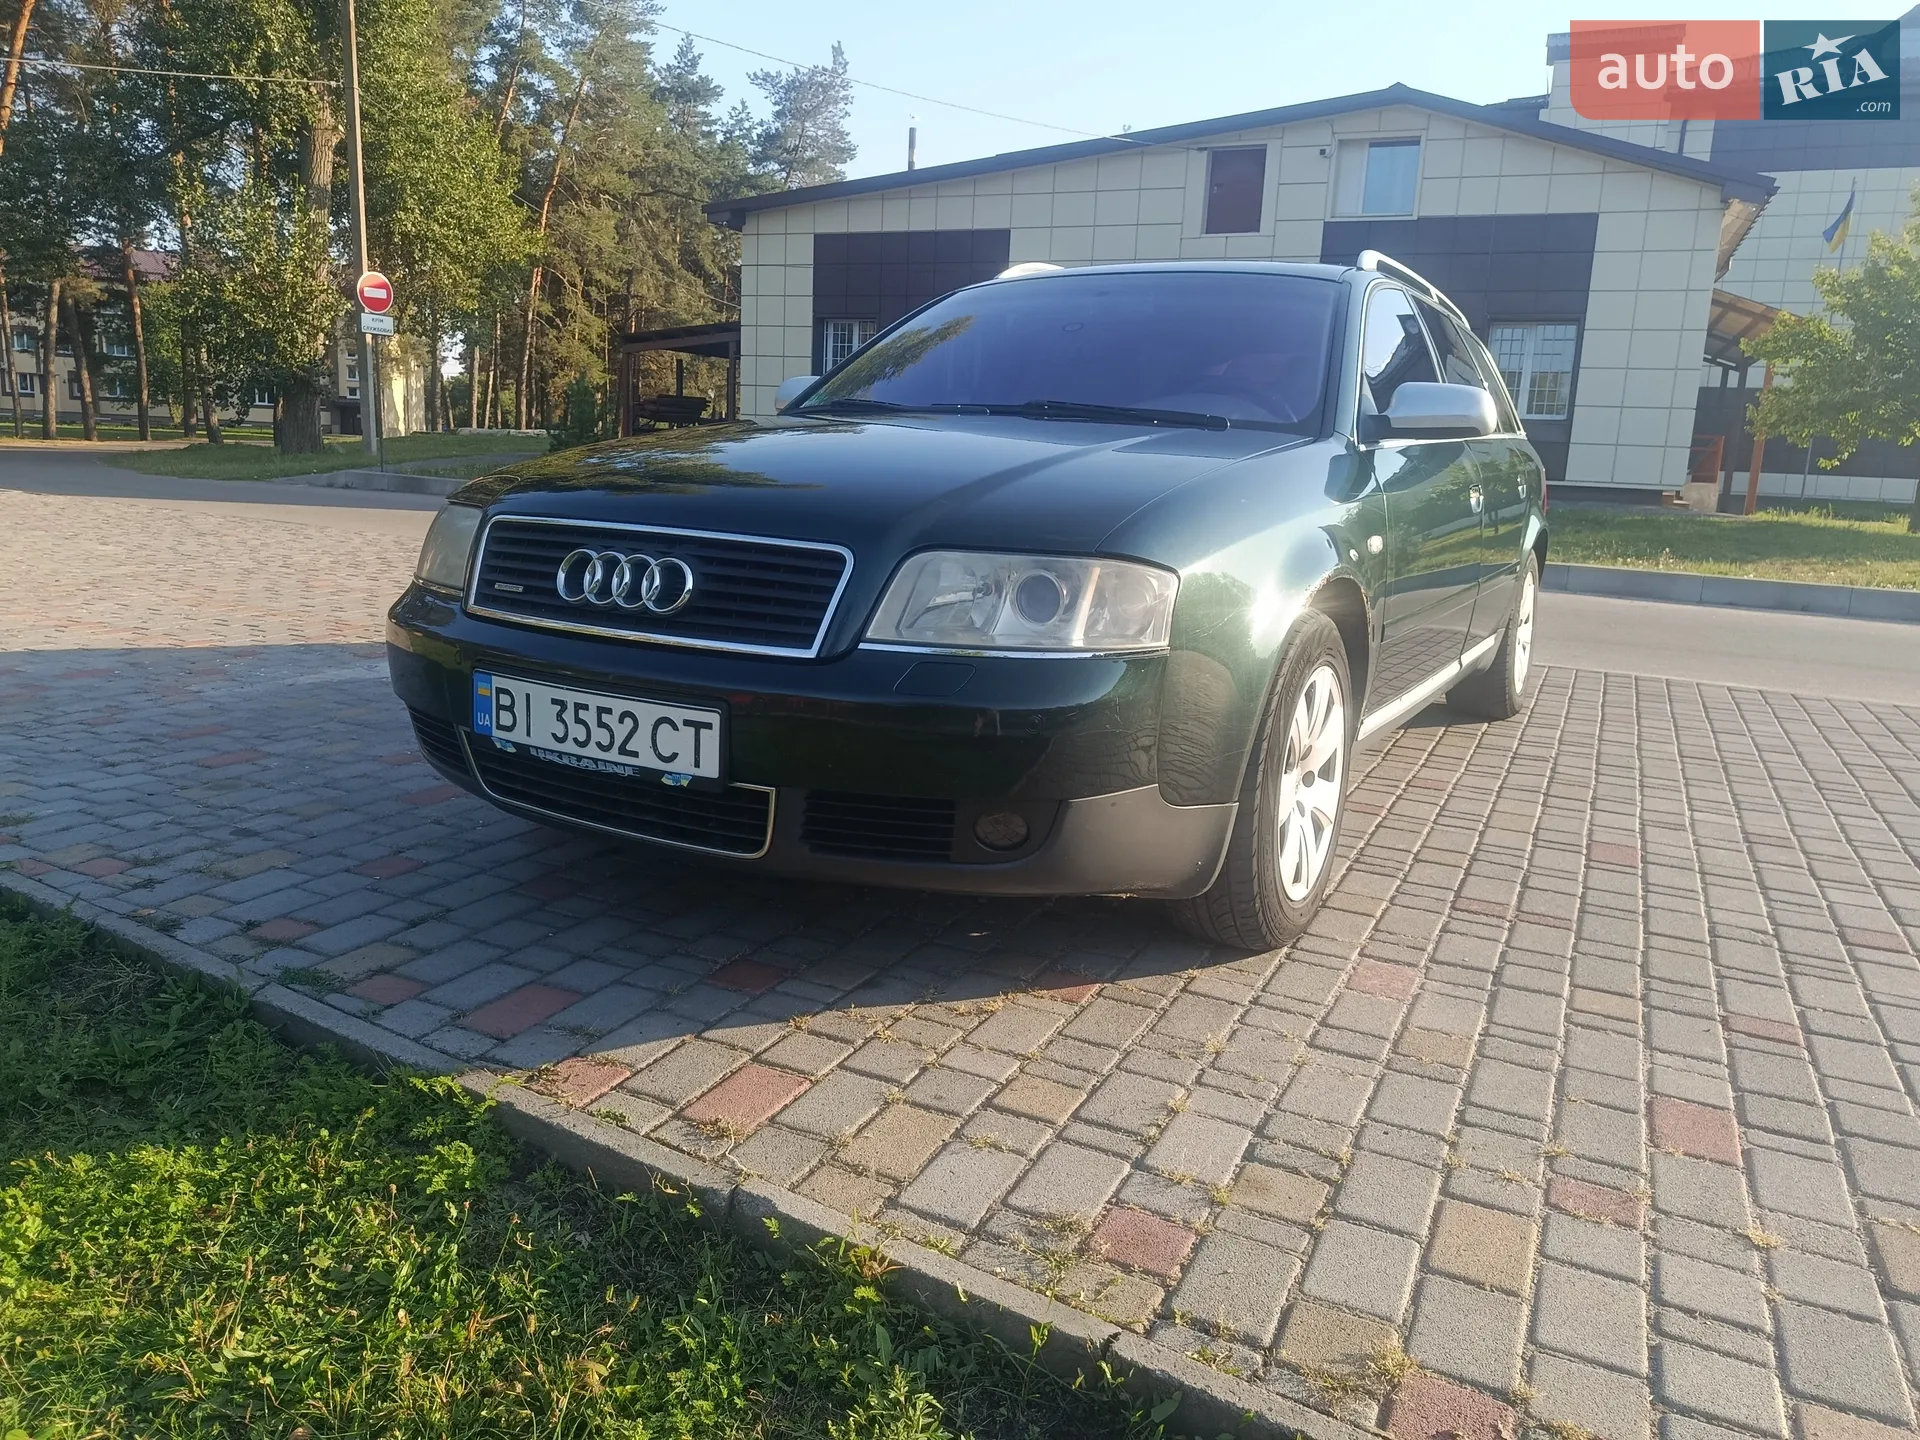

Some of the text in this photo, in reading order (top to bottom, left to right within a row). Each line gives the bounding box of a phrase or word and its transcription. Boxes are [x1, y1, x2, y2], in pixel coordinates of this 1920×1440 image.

[477, 711, 491, 727] UA
[495, 686, 713, 769] BI 3552 CT
[529, 746, 641, 777] UKRAINE
